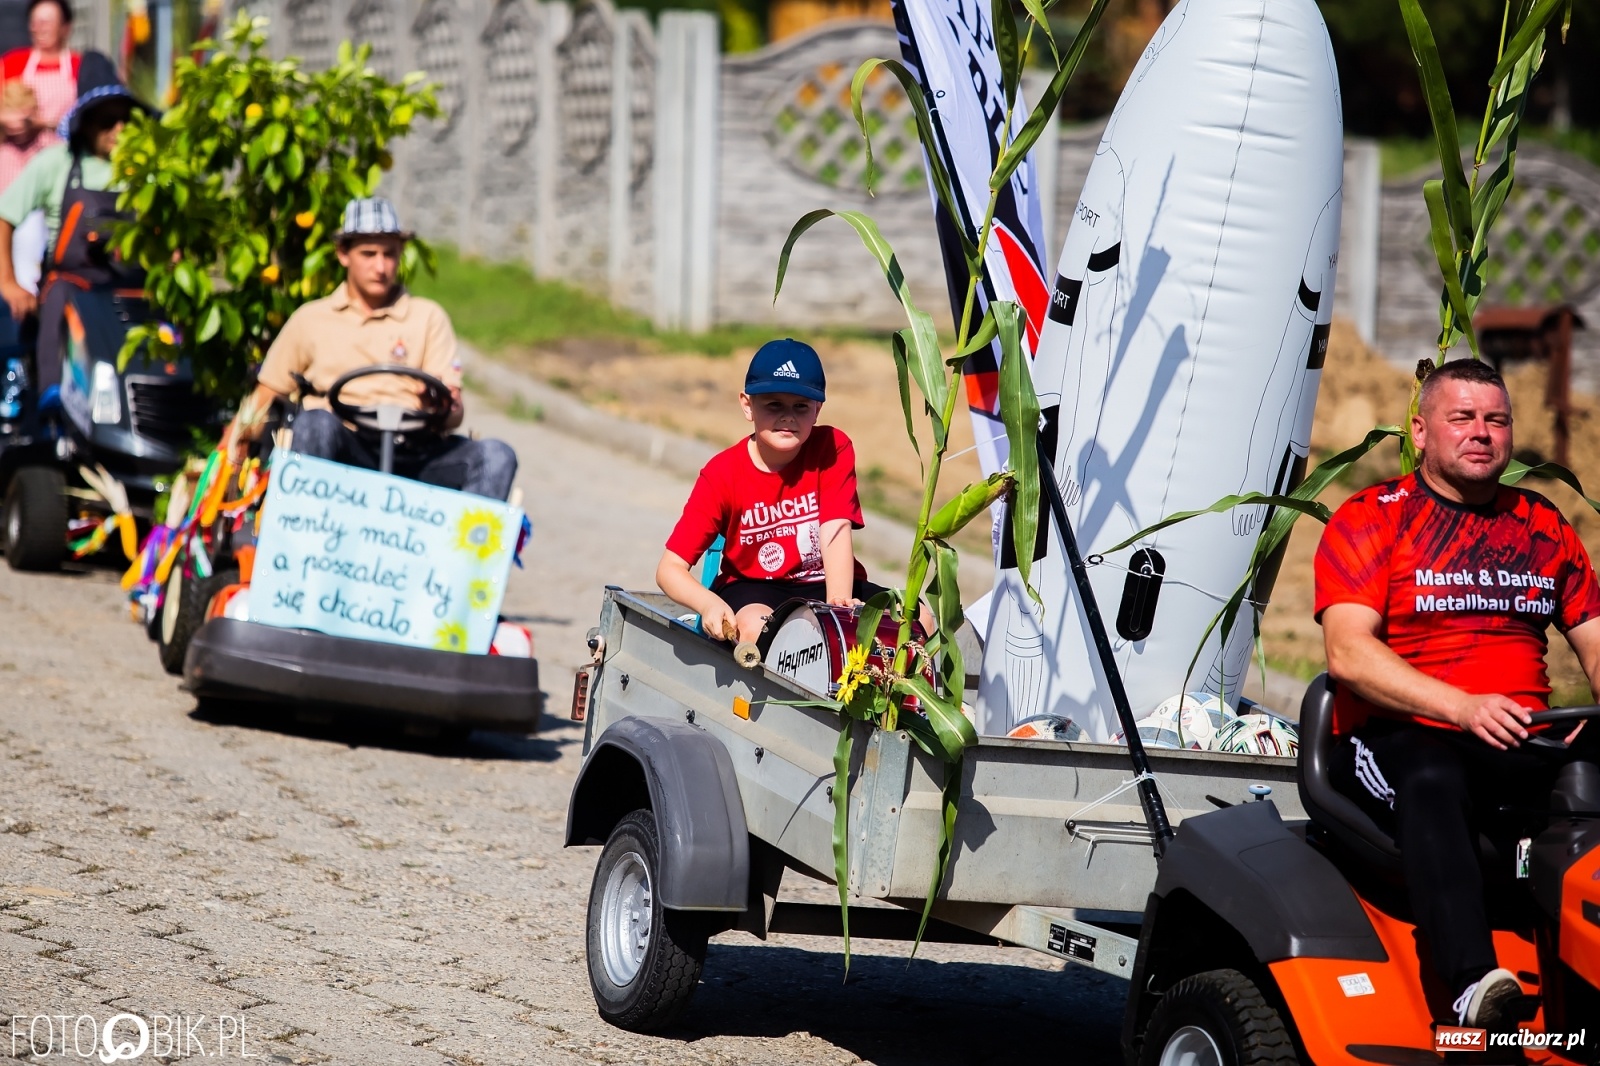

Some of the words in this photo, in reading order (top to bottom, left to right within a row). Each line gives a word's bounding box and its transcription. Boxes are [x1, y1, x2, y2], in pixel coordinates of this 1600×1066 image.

[773, 370, 800, 379] adidas
[278, 460, 368, 508] Czasu
[380, 486, 446, 527] Dużo
[278, 509, 348, 552] renty
[359, 523, 426, 556] mało
[740, 536, 754, 546] FC
[756, 525, 797, 543] BAYERN
[272, 554, 290, 571] a
[301, 554, 409, 592] poszaleć
[424, 567, 452, 618] by
[1415, 569, 1475, 587] Marek
[1478, 570, 1494, 587] &
[1498, 569, 1556, 591] Dariusz
[272, 582, 305, 614] się
[1415, 594, 1510, 612] Metallbau
[1514, 597, 1556, 616] GmbH
